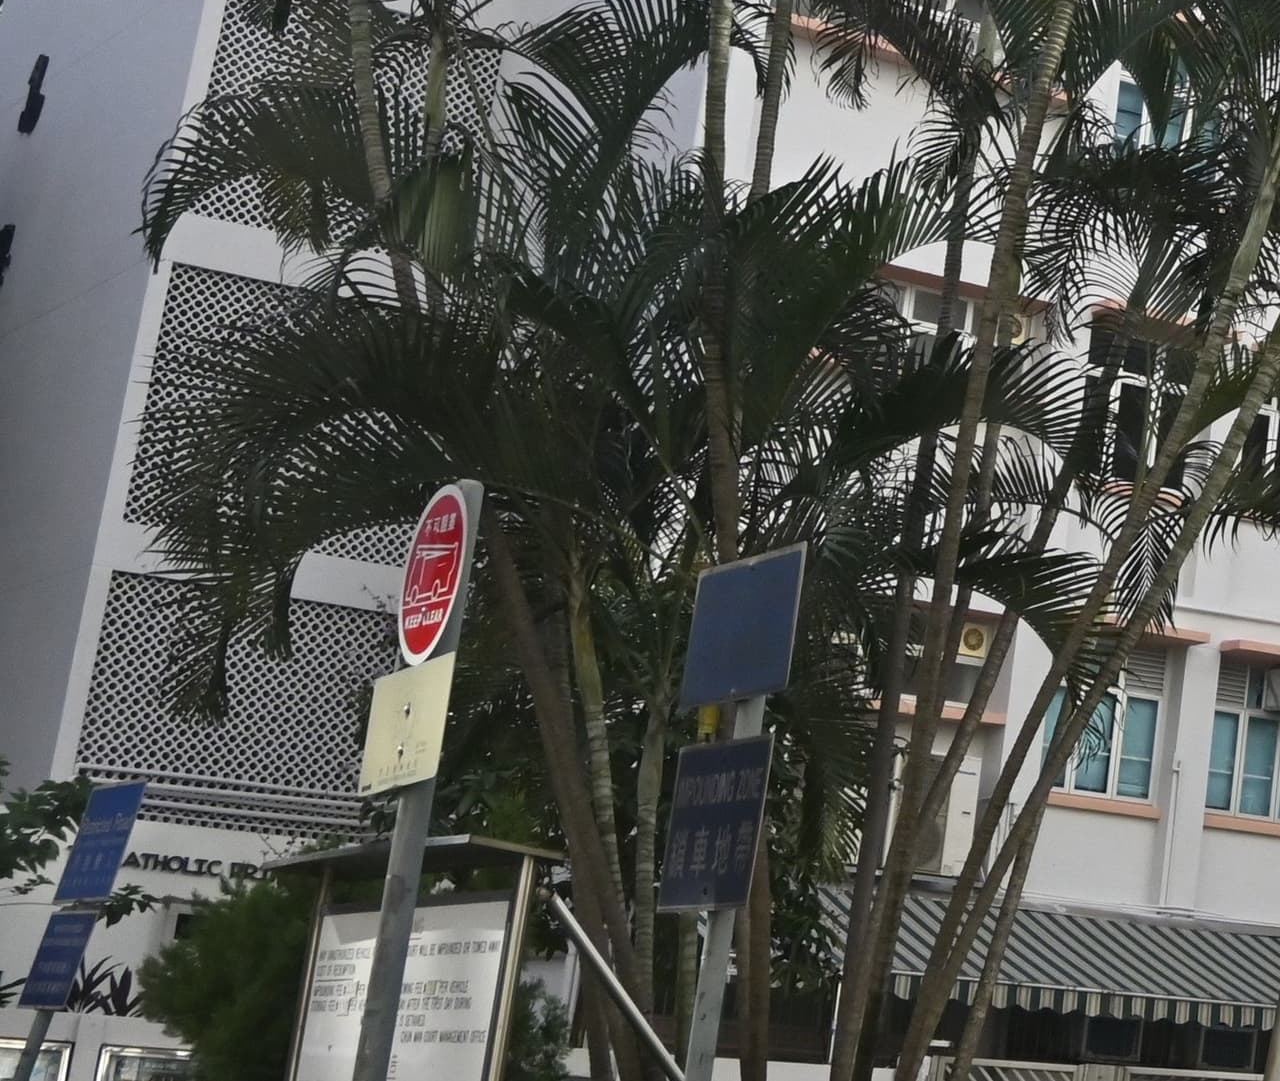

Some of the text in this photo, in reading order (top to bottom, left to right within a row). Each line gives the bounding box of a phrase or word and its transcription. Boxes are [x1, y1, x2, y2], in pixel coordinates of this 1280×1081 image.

[404, 608, 444, 630] KEEP CLEAR
[736, 767, 764, 801] ZONE
[121, 851, 224, 877] ATHOLIC
